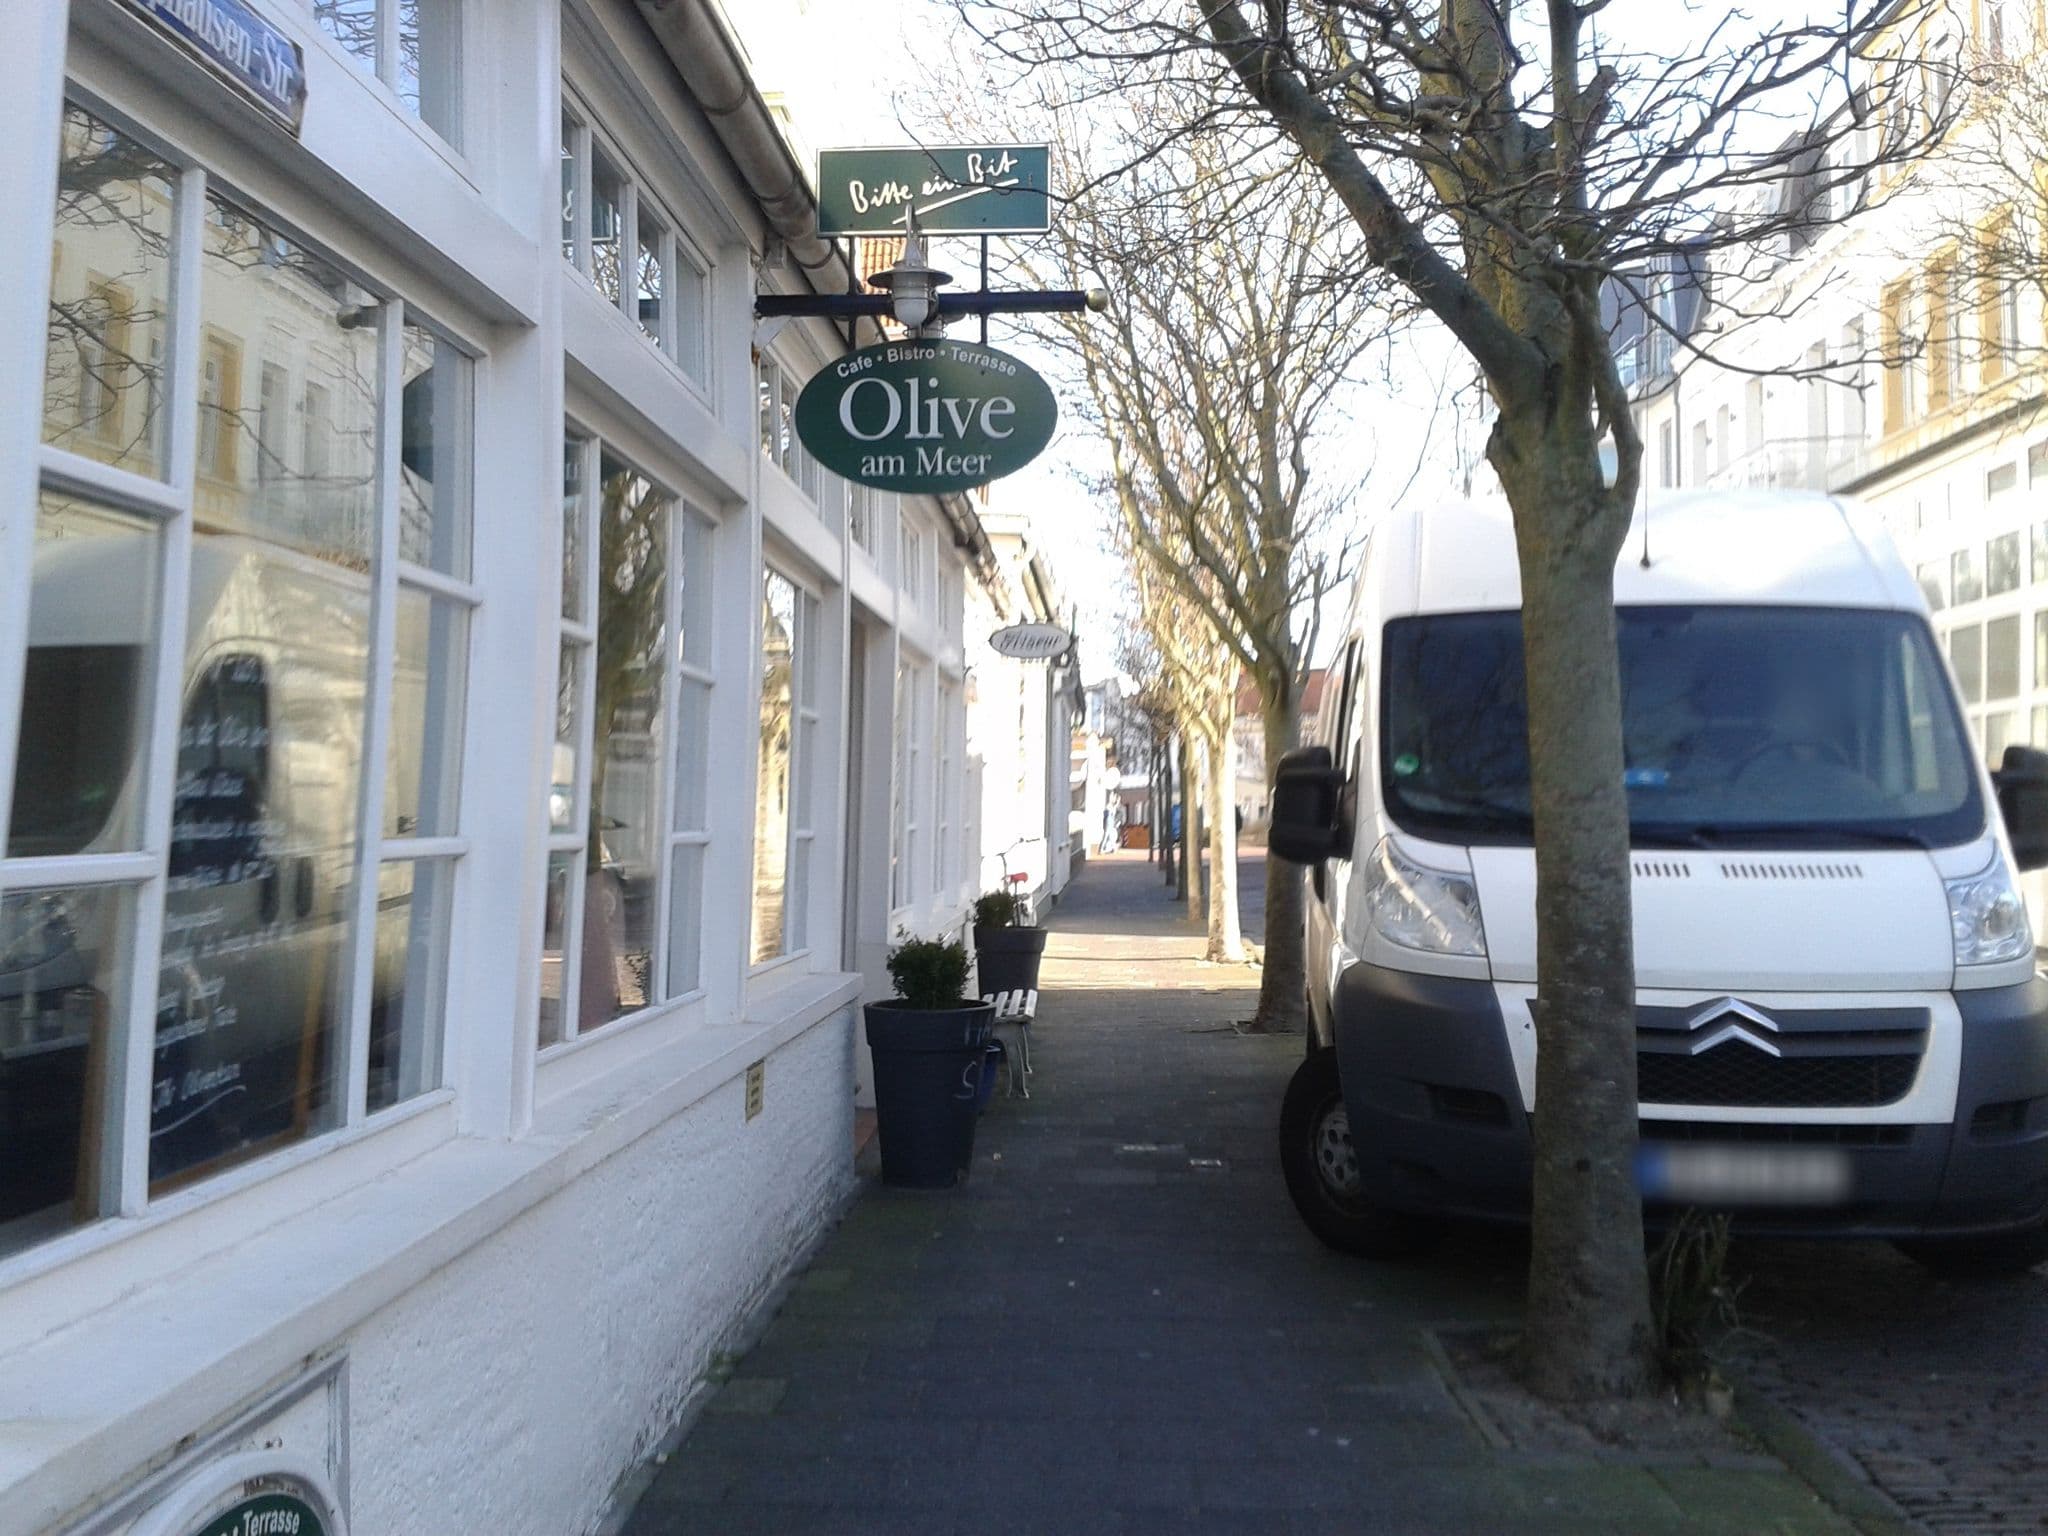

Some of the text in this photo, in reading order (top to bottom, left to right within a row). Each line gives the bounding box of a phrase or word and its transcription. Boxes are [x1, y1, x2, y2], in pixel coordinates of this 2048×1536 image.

[143, 0, 291, 106] ausen-Str.
[850, 150, 1018, 214] Bitte ein Bit
[837, 347, 1016, 377] Cafe Bistro Terrasse
[839, 377, 1016, 441] Olive
[861, 446, 992, 477] am Meer
[243, 1510, 300, 1536] Terrasse
